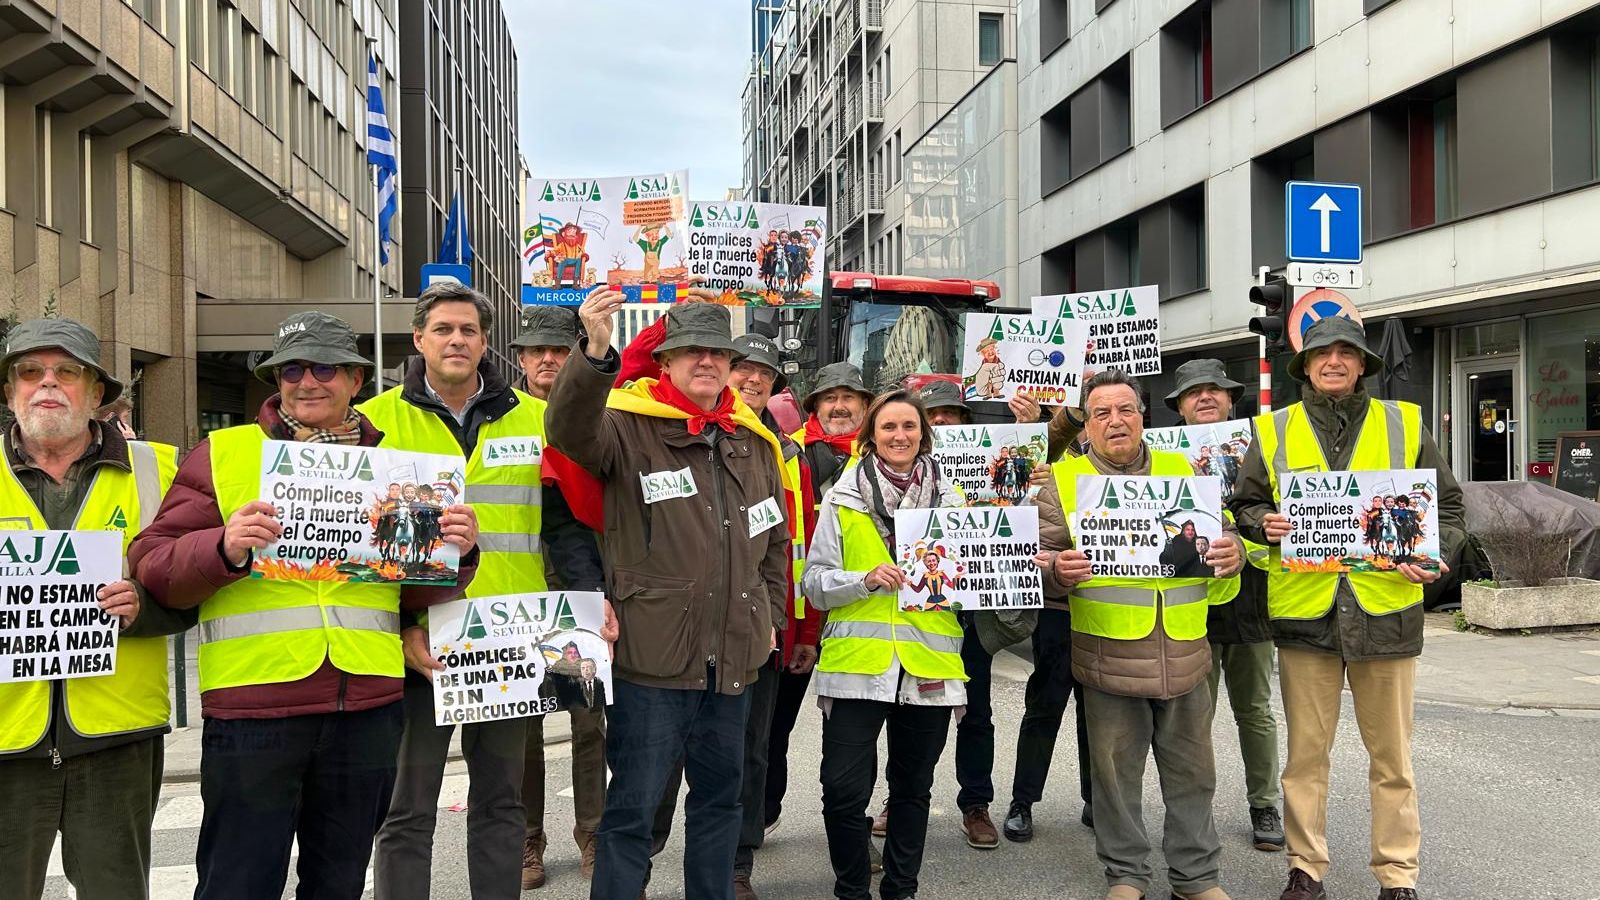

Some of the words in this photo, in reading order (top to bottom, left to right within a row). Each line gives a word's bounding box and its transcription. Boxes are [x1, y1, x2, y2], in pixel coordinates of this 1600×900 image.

[538, 180, 601, 201] ASAJA
[689, 204, 759, 229] ASAJA
[691, 232, 752, 250] Cómplices
[702, 247, 713, 260] la
[716, 250, 757, 262] muerte
[692, 262, 710, 275] del
[713, 262, 753, 279] Campo
[536, 292, 588, 302] MERCOSU
[1058, 290, 1136, 319] ASAJA
[279, 322, 306, 338] ASAJA
[988, 315, 1064, 344] ASAJA
[1090, 324, 1098, 336] SI
[1100, 324, 1114, 336] NO
[1116, 319, 1158, 334] ESTAMOS
[1008, 336, 1042, 344] SEVILLA
[1097, 338, 1109, 350] EN
[1112, 337, 1120, 348] EL
[1124, 333, 1158, 347] CAMPO,
[1099, 349, 1130, 364] HABRÁ
[1133, 347, 1159, 360] NADA
[1135, 361, 1160, 374] MESA
[1008, 369, 1060, 386] ASFIXIAN
[1063, 373, 1078, 387] AL
[1146, 428, 1190, 448] SAJA
[487, 442, 540, 460] ASAJA
[267, 444, 374, 481] ASAJA
[955, 465, 990, 478] muerte
[300, 470, 344, 480] SEVILLA
[273, 482, 363, 506] Cómplices
[646, 473, 692, 498] SAJA
[1095, 478, 1196, 510] ASAJA
[1284, 474, 1361, 500] ASAJA
[290, 502, 305, 522] la
[310, 505, 369, 525] muerte
[750, 504, 777, 526] AJA
[1125, 502, 1166, 510] SEVILLA
[1290, 502, 1354, 518] Cómplices
[921, 508, 1013, 540] ASAJA
[1080, 516, 1150, 531] CÓMPLICES
[1302, 518, 1312, 530] la
[1315, 517, 1360, 530] muerte
[303, 523, 362, 544] Campo
[1082, 535, 1097, 546] DE
[1101, 535, 1128, 546] UNA
[1131, 534, 1158, 547] PAC
[1290, 532, 1311, 544] del
[1312, 531, 1356, 546] Campo
[0, 532, 80, 576] AJA
[277, 544, 348, 563] europeo
[960, 544, 970, 558] SI
[972, 544, 987, 558] NO
[990, 542, 1038, 556] ESTAMOS
[1084, 550, 1116, 562] SIN
[1296, 546, 1348, 560] europeo
[0, 566, 34, 576] ILLA
[968, 561, 982, 574] EN
[984, 560, 995, 574] EL
[998, 558, 1038, 575] CAMPO,
[1091, 564, 1176, 576] GRICULTORES
[952, 578, 968, 590] NO
[970, 574, 1006, 590] HABRÁ
[1010, 576, 1040, 590] NADA
[6, 584, 34, 605] NO
[980, 594, 992, 607] EN
[996, 593, 1010, 607] LA
[1012, 592, 1042, 606] MESA
[0, 610, 20, 630] EN
[26, 609, 44, 628] EL
[50, 608, 116, 628] CAMPO,
[456, 593, 578, 642] ASAJA
[493, 626, 544, 638] SEVILLA
[0, 630, 60, 655] HABRÁ
[66, 630, 114, 651] NADA
[12, 658, 35, 678] EN
[40, 656, 62, 676] LA
[68, 653, 113, 674] MESA
[438, 646, 527, 669] CÓMPLICES
[440, 673, 460, 688] DE
[464, 669, 498, 686] UNA
[502, 663, 536, 682] PAC
[442, 688, 484, 707] SIN
[442, 697, 558, 724] AGRICULTORES
